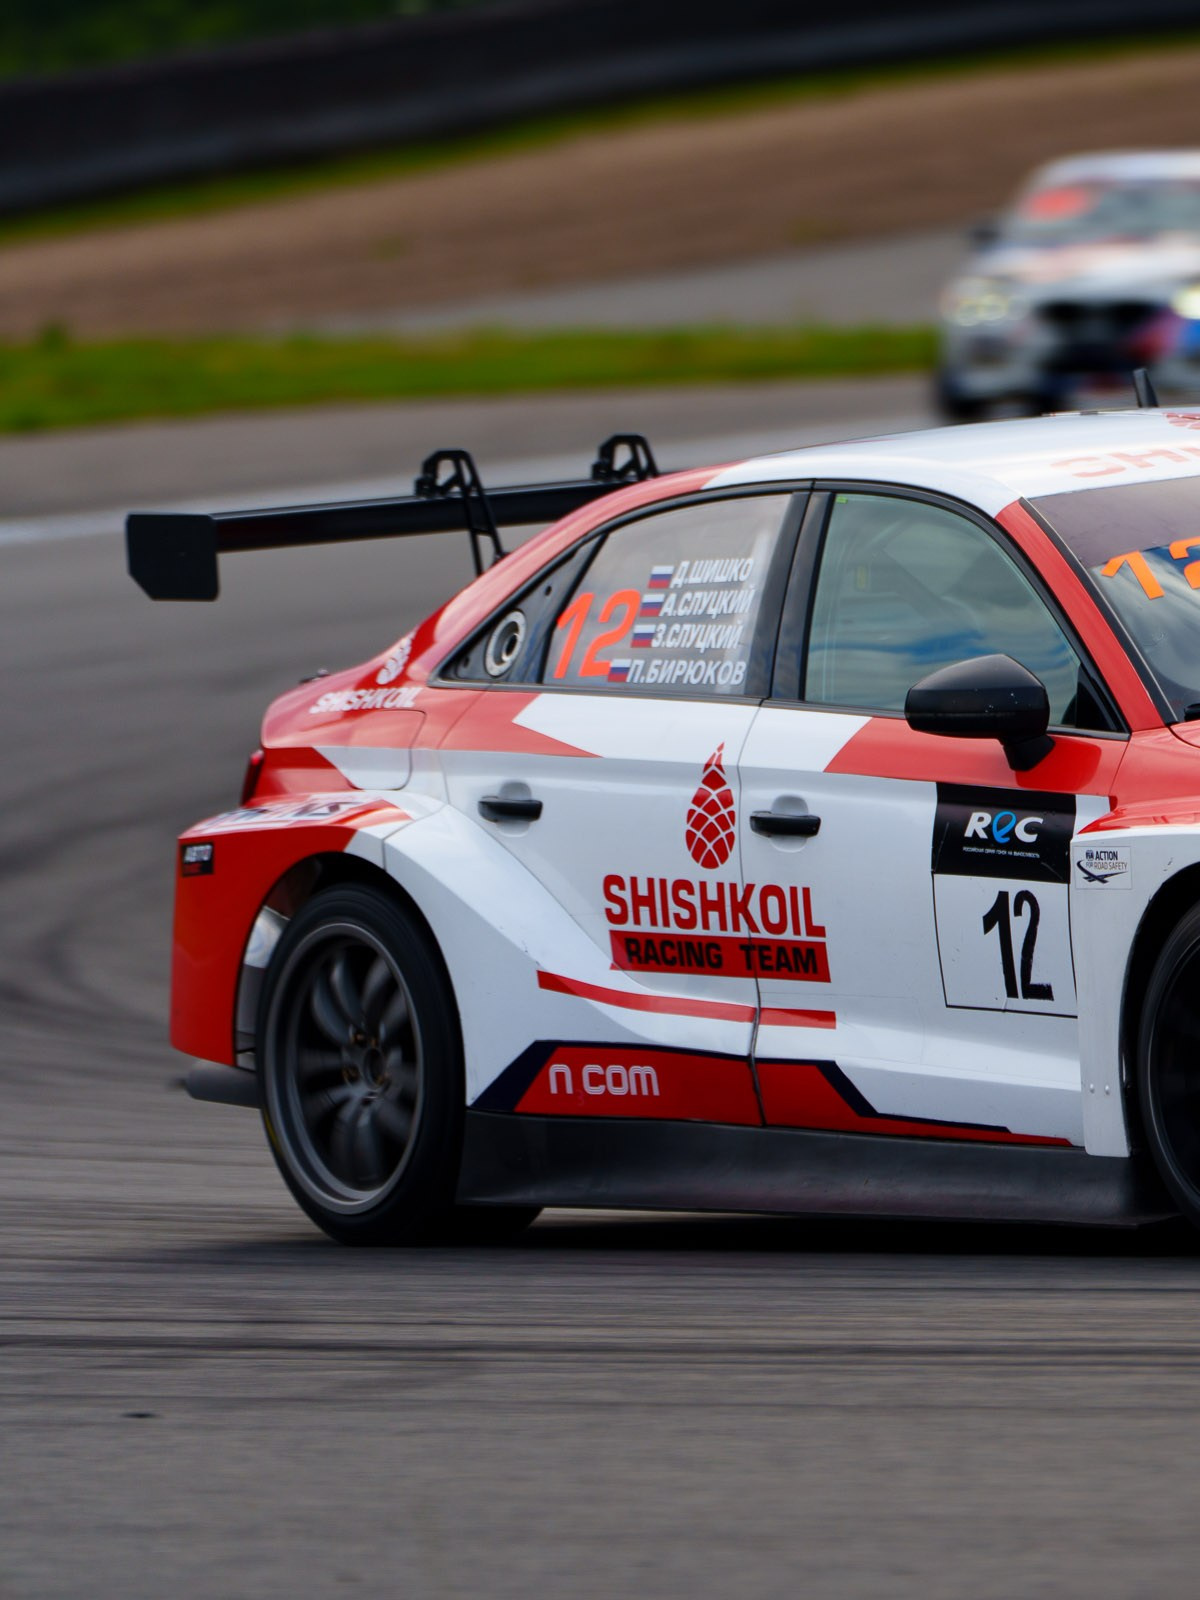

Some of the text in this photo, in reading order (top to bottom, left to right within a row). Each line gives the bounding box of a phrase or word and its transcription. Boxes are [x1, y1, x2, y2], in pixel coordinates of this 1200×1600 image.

[669, 558, 754, 589] Д.ШИШКО
[658, 585, 756, 619] А.СЛУЦКИЙ
[553, 588, 641, 679] 12
[626, 659, 747, 685] П.БИРЮКОВ
[1094, 862, 1108, 870] ROAD
[1109, 861, 1128, 870] SAFETY
[1095, 850, 1118, 861] ACTION
[603, 874, 826, 938] SHISHKOIL
[624, 937, 818, 975] RACING TEAM
[982, 890, 1055, 1001] 12
